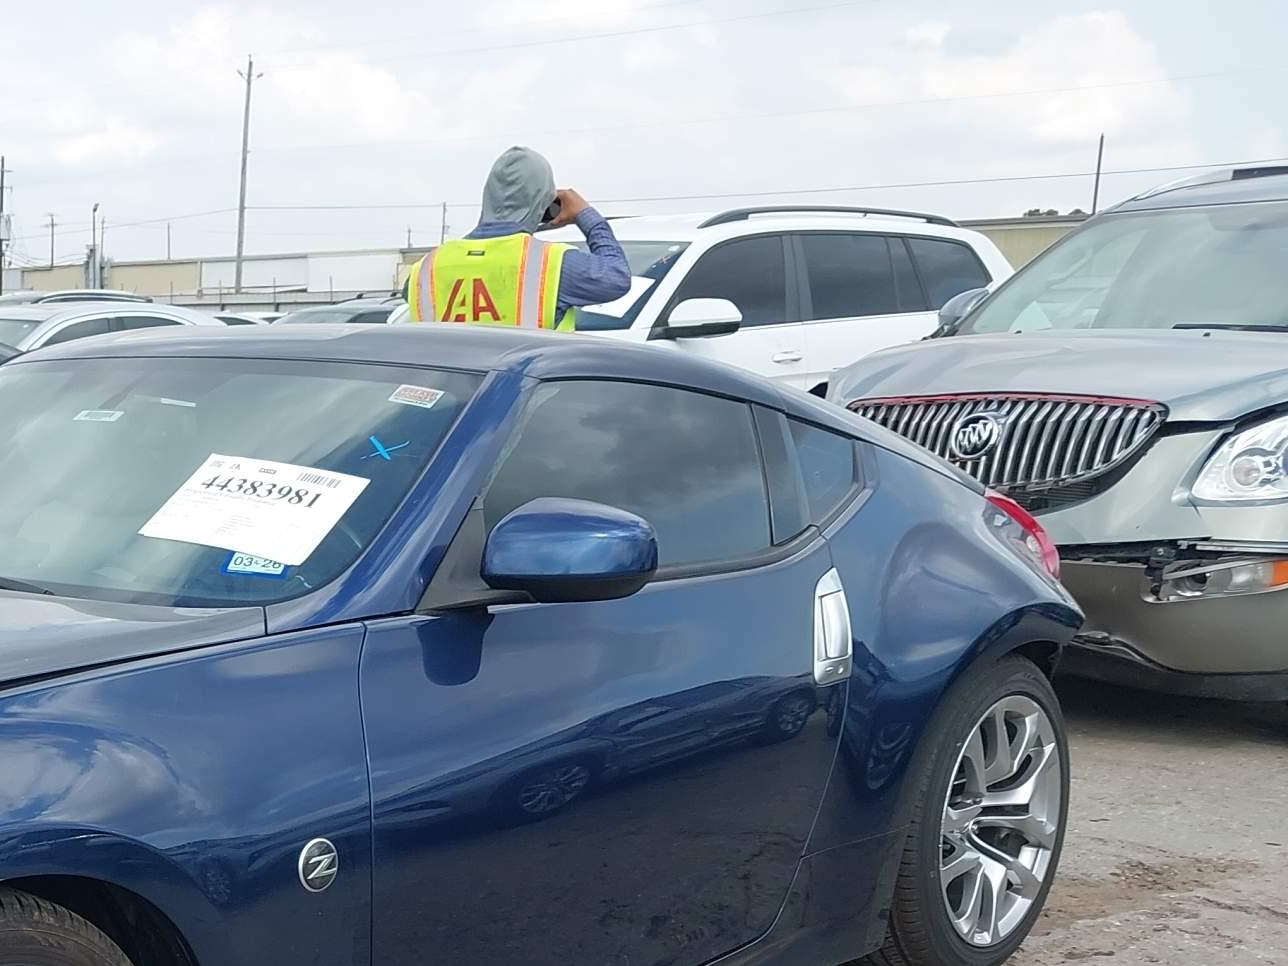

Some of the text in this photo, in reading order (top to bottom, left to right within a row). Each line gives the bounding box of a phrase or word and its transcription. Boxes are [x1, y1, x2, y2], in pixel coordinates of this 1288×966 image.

[200, 474, 323, 508] 44383981
[233, 556, 282, 569] 03 26
[306, 852, 337, 879] Z
